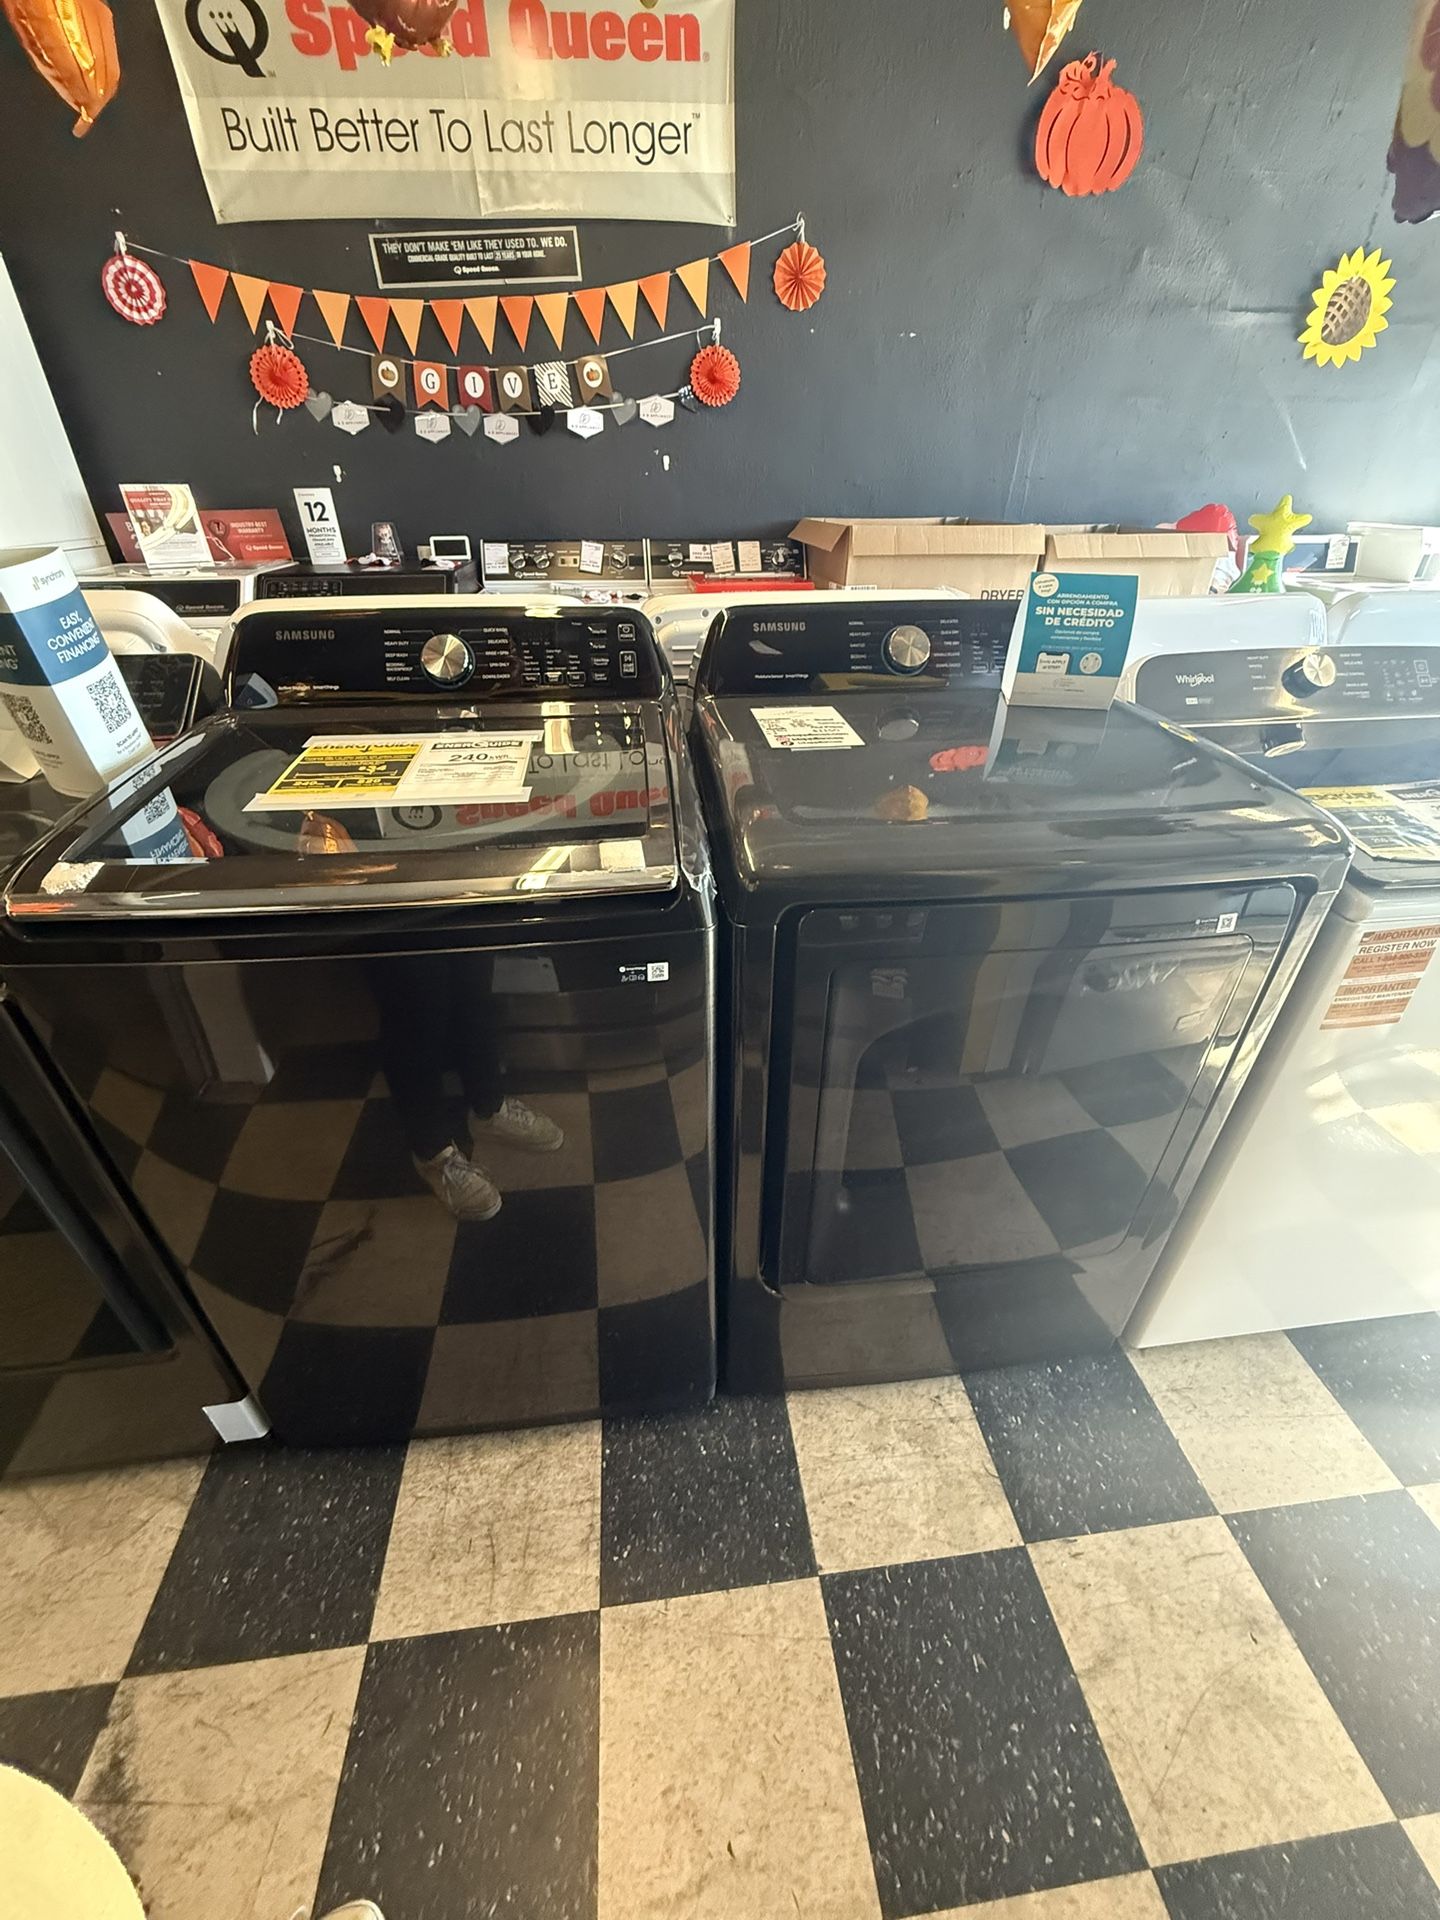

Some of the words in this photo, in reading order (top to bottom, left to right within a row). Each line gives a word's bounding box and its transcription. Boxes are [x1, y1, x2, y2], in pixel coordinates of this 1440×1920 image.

[284, 0, 490, 71] Spd
[508, 0, 701, 62] Queen
[221, 106, 299, 152] Built
[309, 107, 419, 152] Better
[429, 109, 472, 153] To
[484, 109, 554, 153] Last
[382, 241, 401, 254] THEY
[403, 241, 425, 253] DON'T
[427, 240, 450, 252] MAKE
[466, 239, 483, 250] LIKE
[484, 238, 503, 250] THEY
[504, 237, 525, 249] USED
[526, 236, 539, 248] TO.
[540, 236, 553, 248] WE
[554, 235, 568, 247] DO.
[303, 501, 330, 522] 12
[306, 526, 336, 534] MONTHS
[1035, 606, 1055, 615] SIN
[1057, 606, 1125, 618] NECESIDAD
[59, 610, 83, 630] EASY,
[753, 621, 806, 632] SAMSUNG
[1044, 617, 1062, 626] DE
[1063, 615, 1115, 628] CRÉDITO
[275, 629, 336, 641] SAMSUNG
[1175, 672, 1214, 687] Whirlpool
[448, 753, 488, 763] 240
[1358, 942, 1410, 954] REGISTER
[1411, 940, 1437, 949] NOW
[1353, 957, 1374, 965] CALL
